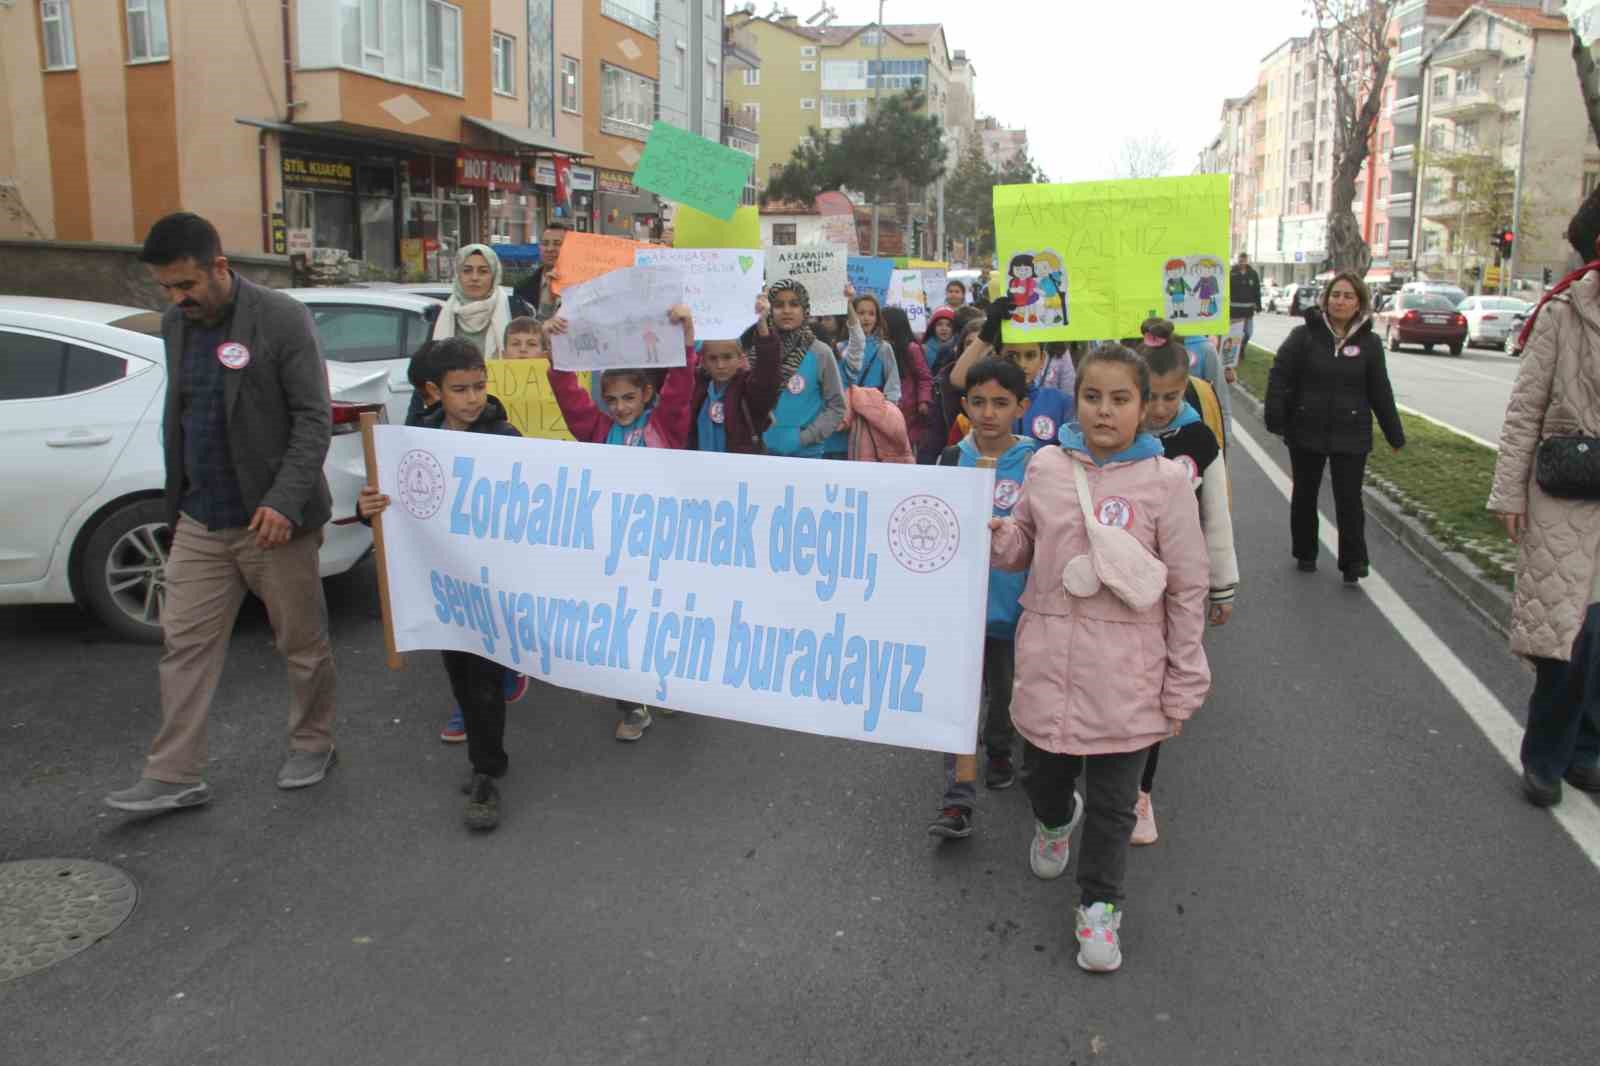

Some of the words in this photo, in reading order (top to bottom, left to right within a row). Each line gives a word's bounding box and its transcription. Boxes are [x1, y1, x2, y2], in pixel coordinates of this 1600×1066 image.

[464, 159, 487, 178] HOT
[490, 160, 520, 185] POINT
[448, 456, 600, 549] Zorbalık
[604, 482, 758, 582] yapmak
[769, 483, 878, 602] değil,
[429, 566, 499, 656] sevgi
[498, 586, 637, 676] yaymak
[641, 588, 717, 700] için
[722, 600, 928, 732] buradayız
